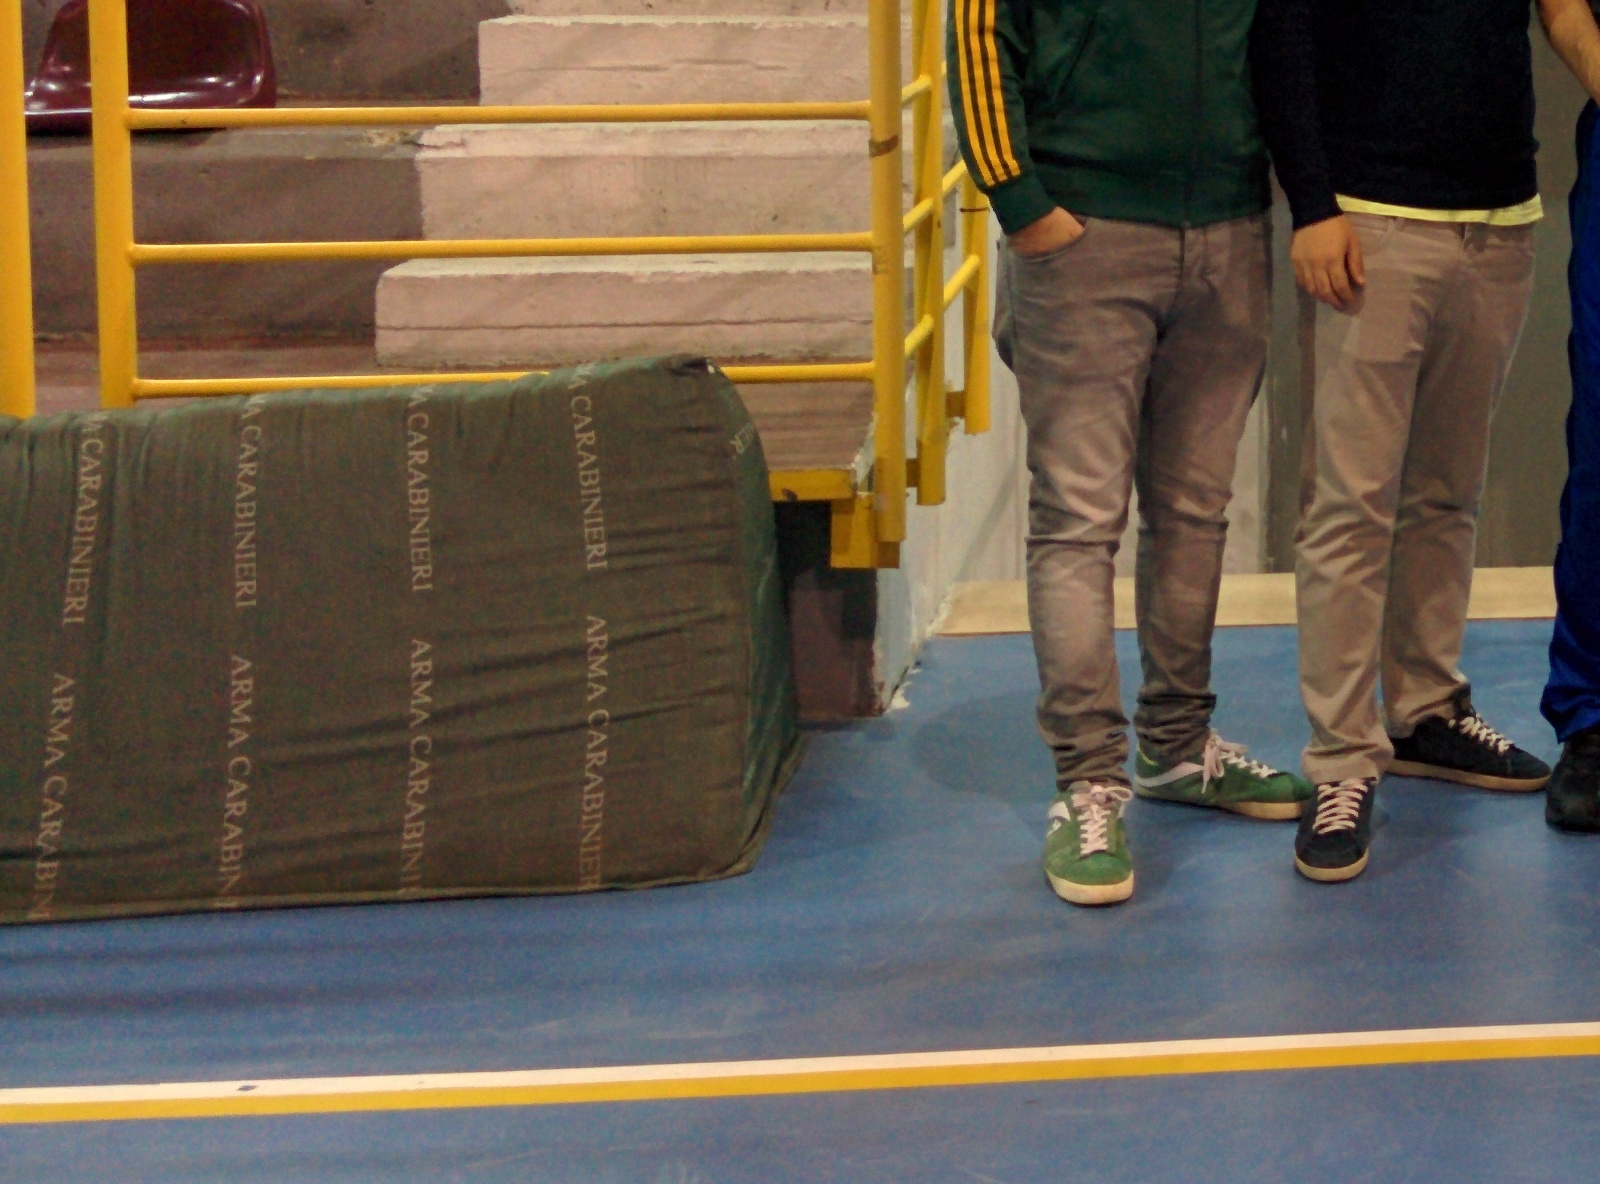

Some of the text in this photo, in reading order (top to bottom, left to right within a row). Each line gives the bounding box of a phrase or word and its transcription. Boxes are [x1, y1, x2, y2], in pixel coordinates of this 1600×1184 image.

[62, 438, 104, 625] CARABINIERI
[234, 425, 261, 607] CARABINIERI
[407, 412, 433, 592] CARABINIERI
[570, 395, 608, 570] CARABINIERI
[44, 672, 75, 767] ARMA
[227, 655, 253, 748] ARMA
[409, 638, 432, 727] ARMA
[586, 615, 608, 702] ARMA
